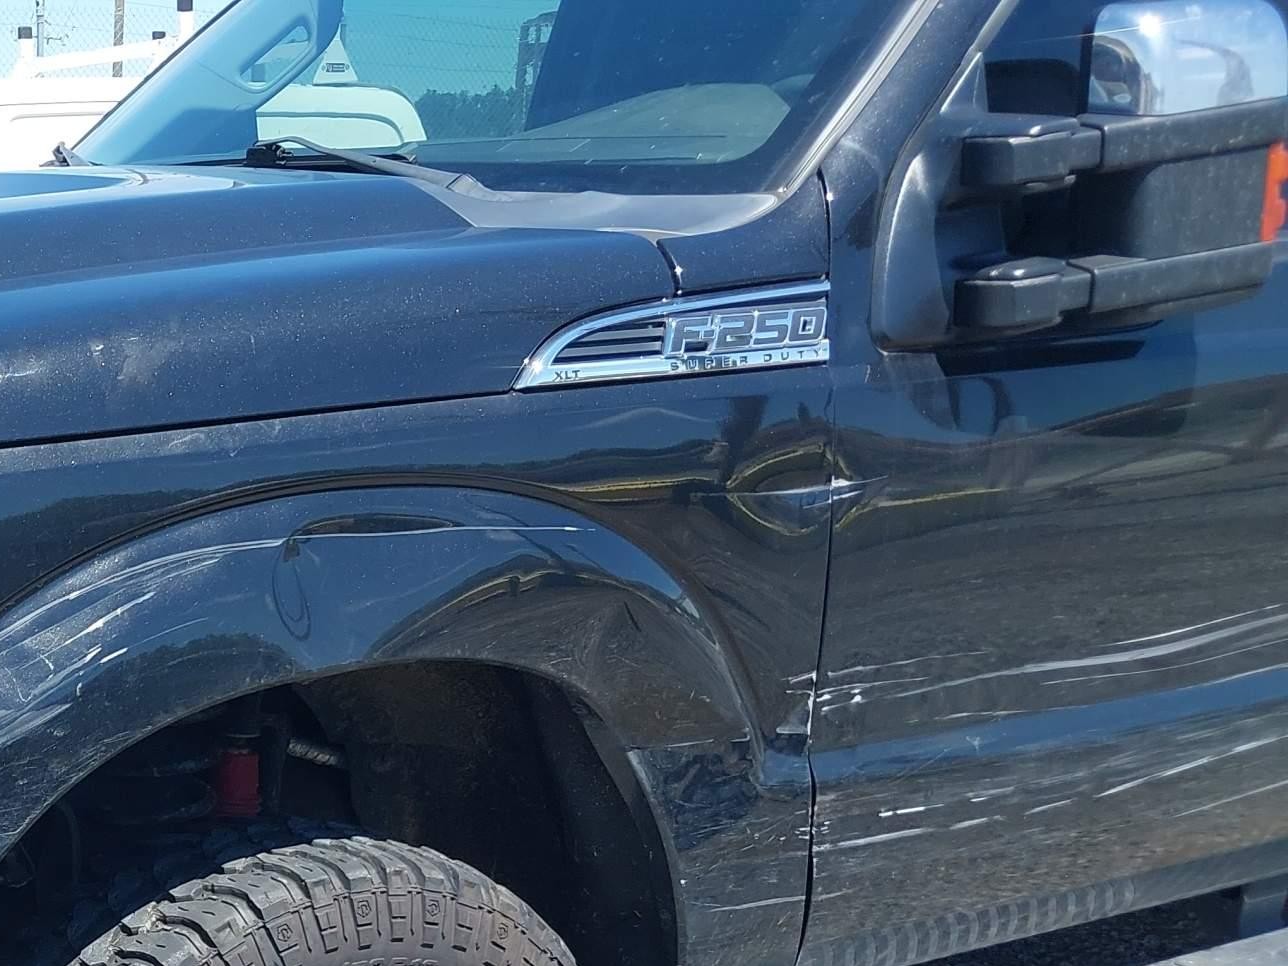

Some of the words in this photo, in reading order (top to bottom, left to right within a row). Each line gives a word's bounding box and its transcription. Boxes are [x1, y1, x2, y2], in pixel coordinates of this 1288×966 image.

[670, 307, 828, 355] F-250
[670, 356, 749, 371] SUPER
[763, 348, 821, 364] DUTY
[553, 369, 580, 381] XLT
